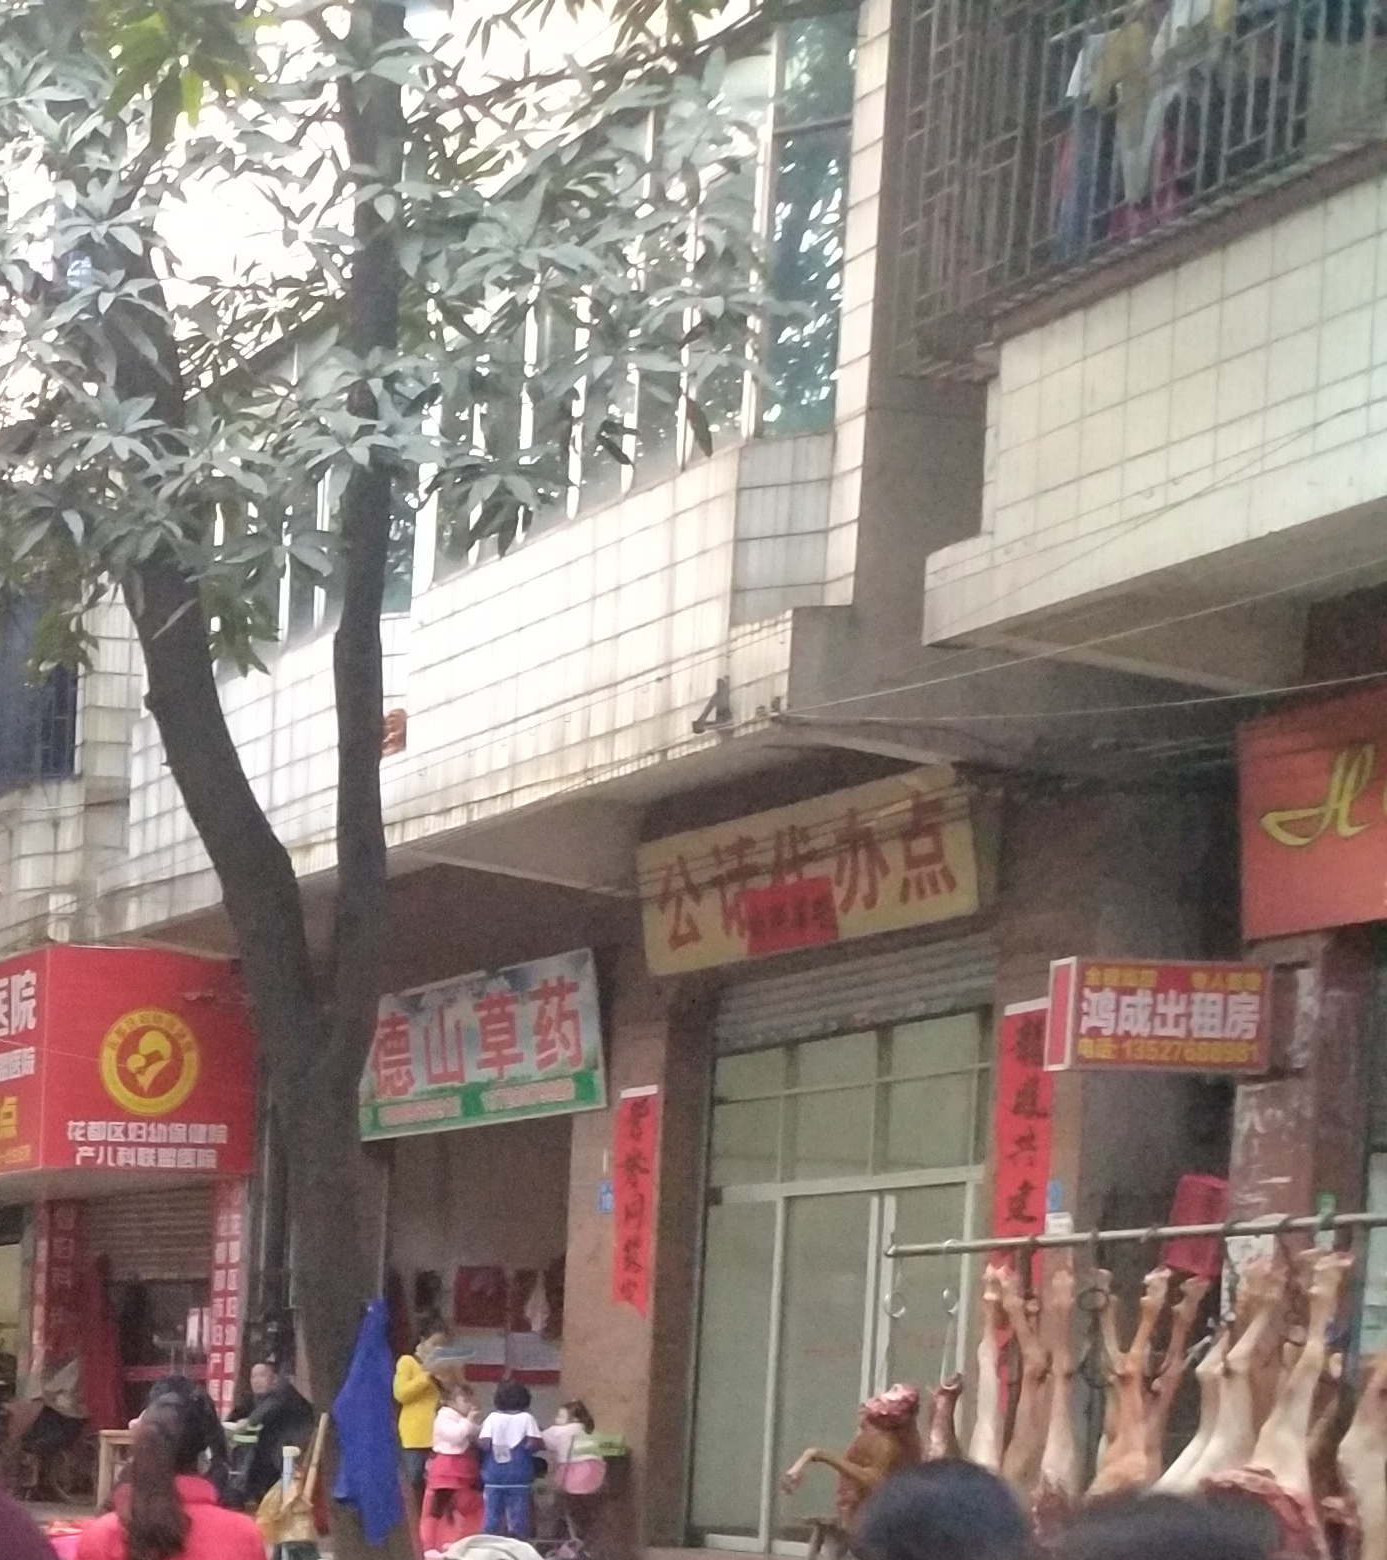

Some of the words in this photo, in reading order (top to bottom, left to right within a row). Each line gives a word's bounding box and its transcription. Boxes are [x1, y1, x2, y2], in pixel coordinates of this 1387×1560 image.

[369, 974, 585, 1098] 德山草药
[1079, 986, 1261, 1039] 鸿成出租房
[75, 1145, 218, 1170] 产儿科联盟医院
